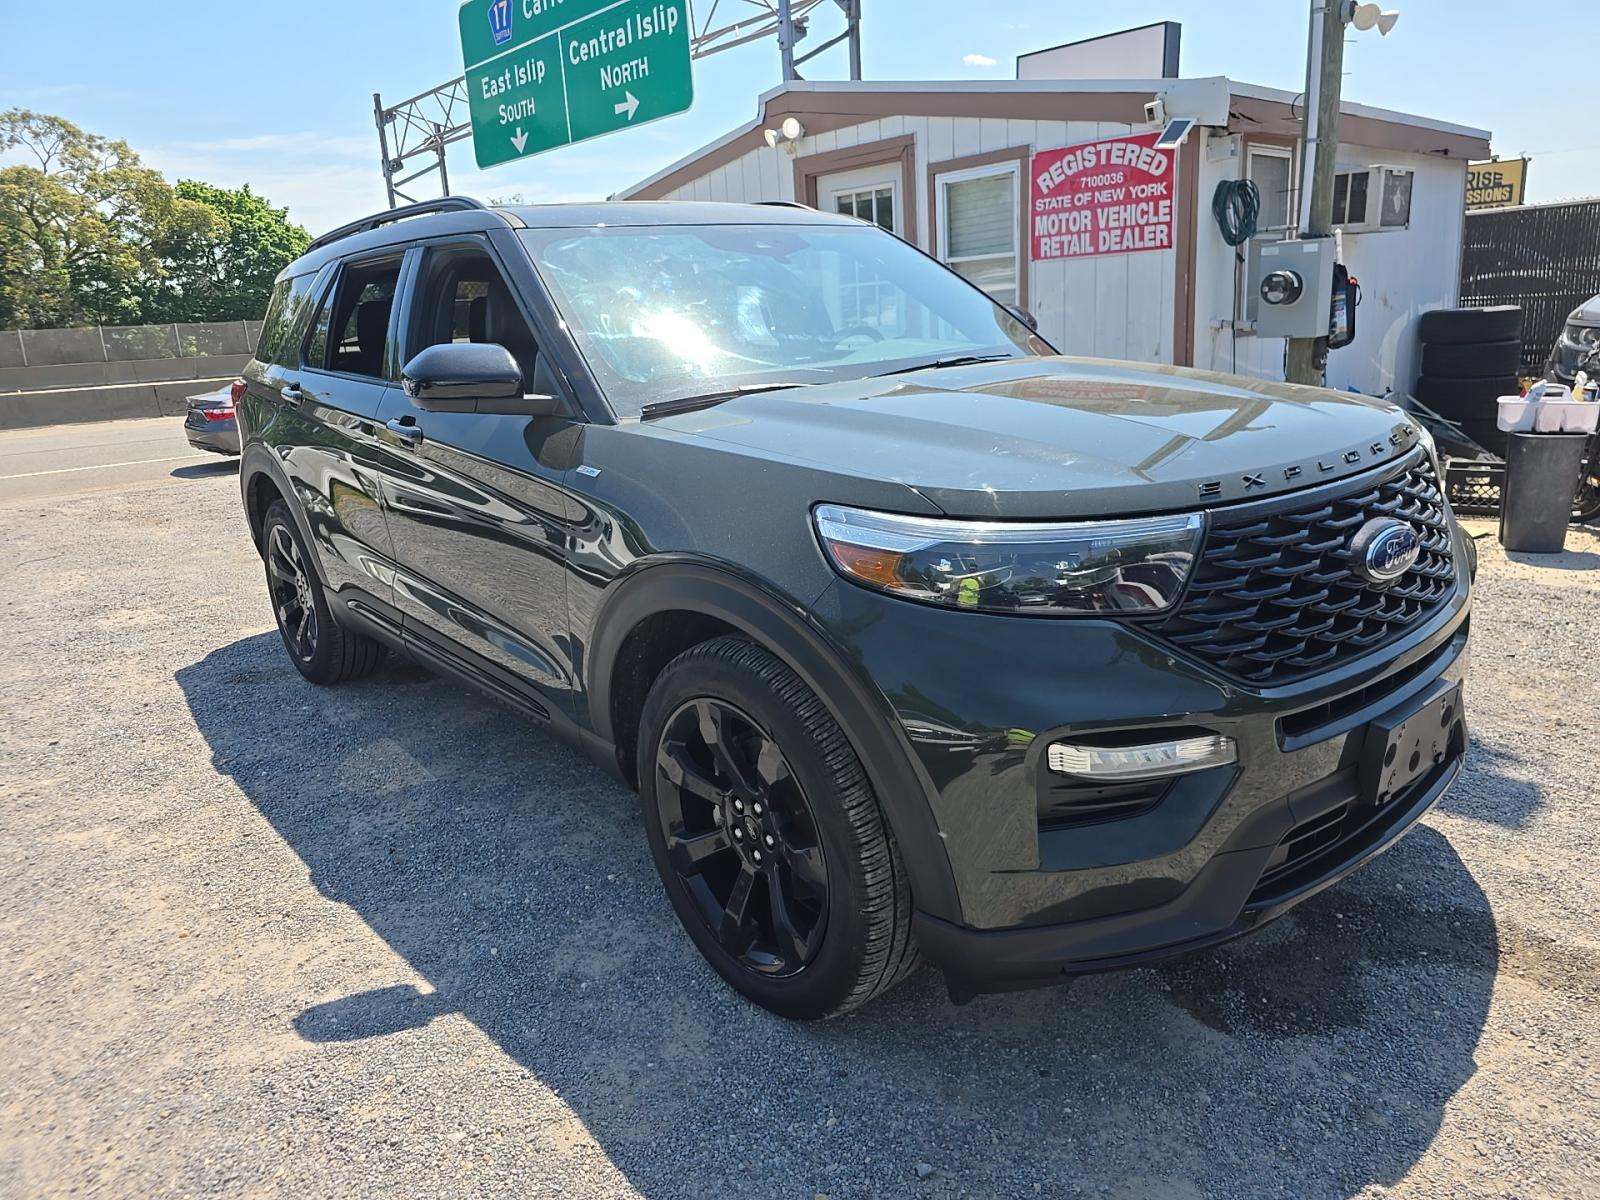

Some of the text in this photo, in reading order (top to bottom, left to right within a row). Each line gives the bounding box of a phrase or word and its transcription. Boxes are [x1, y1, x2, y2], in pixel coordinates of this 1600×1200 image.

[493, 0, 508, 30] 17
[569, 4, 678, 65] Central Islip
[481, 58, 546, 99] East Islip
[600, 56, 649, 91] NORTH
[499, 97, 536, 125] SOUTH
[1036, 142, 1168, 195] REGISTERED
[1081, 172, 1124, 189] 7100036
[1036, 181, 1168, 211] STATE OF NEW YORK
[1035, 200, 1171, 237] MOTOR VEHICLE
[1040, 224, 1169, 258] RETAIL DEALER
[1198, 426, 1415, 496] EXPLORER
[1385, 536, 1413, 569] Ford
